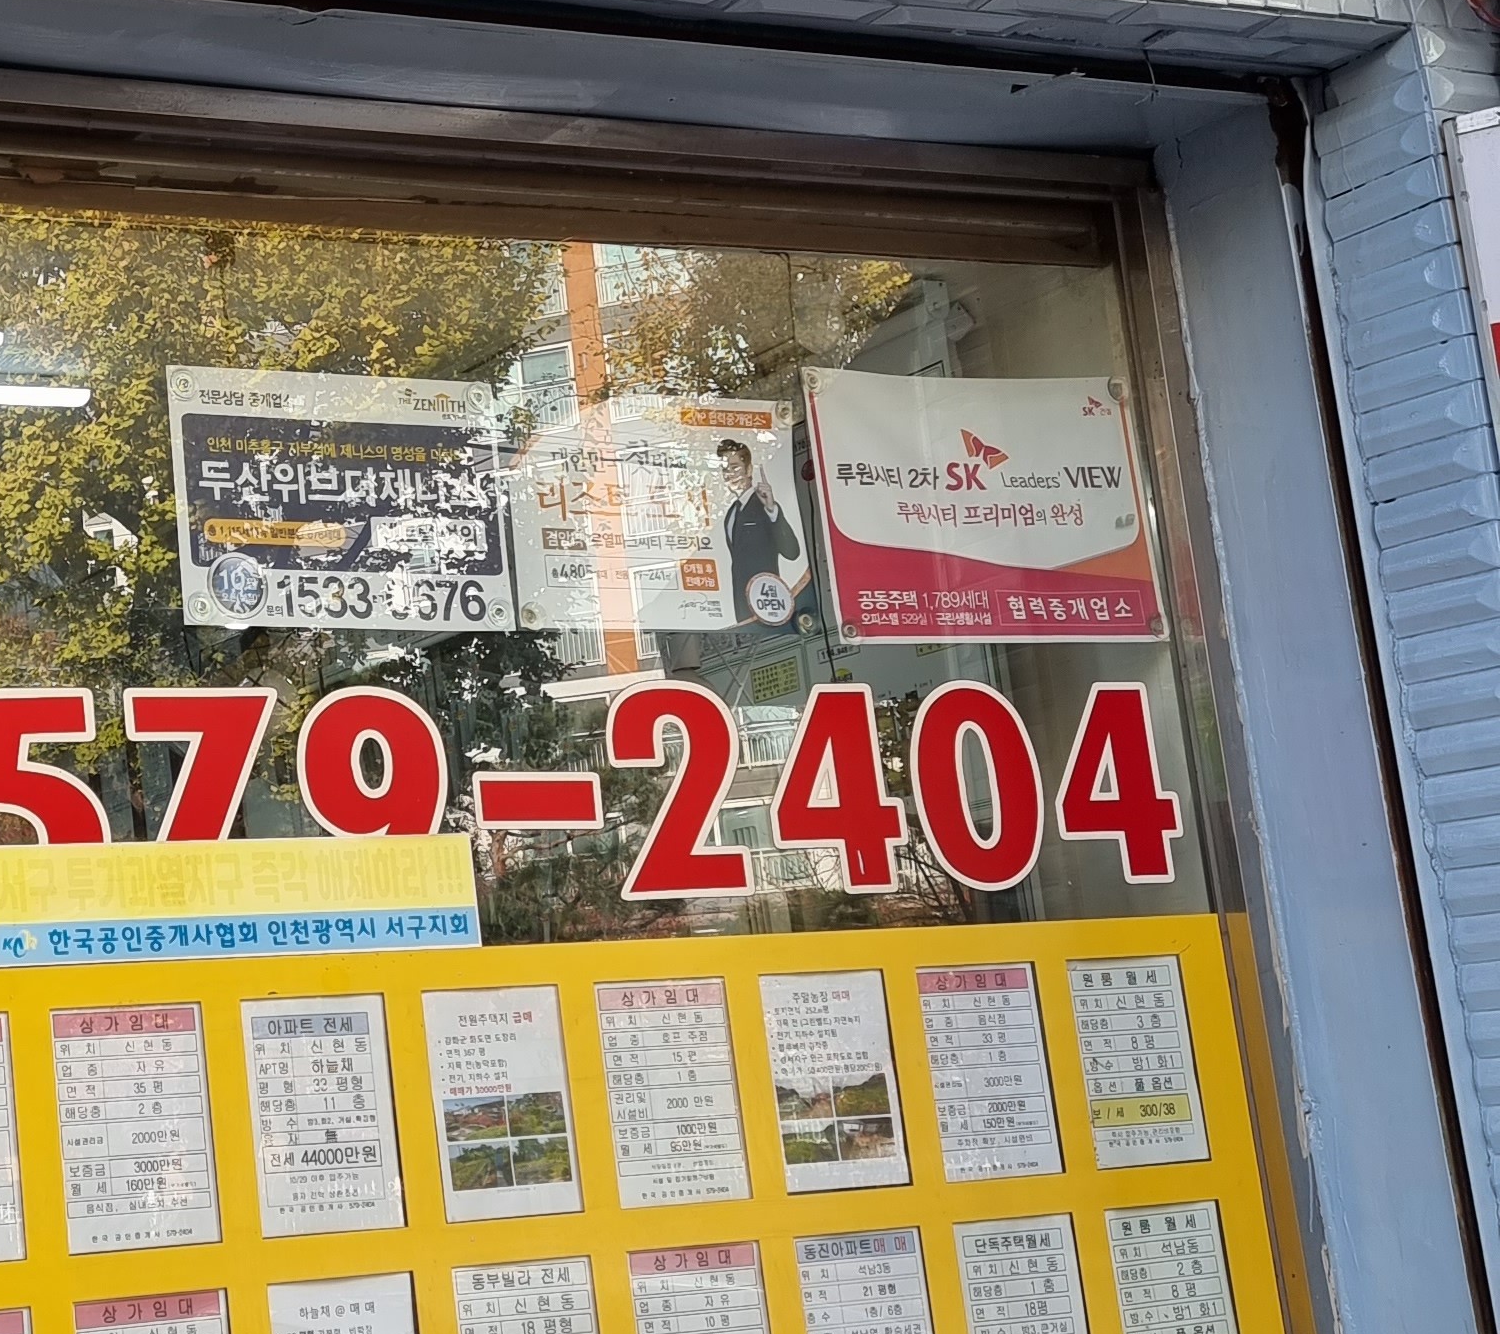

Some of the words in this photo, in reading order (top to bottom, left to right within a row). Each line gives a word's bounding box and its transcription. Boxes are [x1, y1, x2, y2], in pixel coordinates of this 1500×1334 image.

[199, 390, 244, 405] 전문상담
[1082, 407, 1095, 416] SK
[206, 436, 232, 453] 인천
[340, 443, 387, 459] 제니스의
[391, 446, 426, 462] 명성을
[836, 464, 902, 490] 루원시티
[908, 468, 939, 490] 2차
[945, 463, 988, 491] SK
[1062, 467, 1122, 489] VIEW
[897, 502, 958, 527] 루원시티
[964, 504, 1047, 527] 프리미엄의
[1050, 503, 1083, 526] 완성
[665, 536, 713, 550] 푸르지오
[760, 583, 777, 597] 4월
[756, 599, 786, 611] OPEN
[858, 591, 918, 610] 공동주택
[923, 591, 989, 610] 1,789세대
[1007, 595, 1134, 620] 협력중개업소
[861, 613, 899, 626] 오피스텔
[902, 614, 928, 625] 529실
[936, 613, 992, 626] 근린생활시설
[0, 858, 58, 913] 서구
[67, 855, 245, 909] 투기과열지구
[251, 850, 307, 904] 즉각
[48, 926, 258, 957] 한국공인중개사협회
[267, 919, 376, 948] 인천광역시
[385, 911, 469, 941] 서구지회
[268, 1017, 315, 1035] 아파트
[324, 1016, 353, 1034] 전세
[311, 1057, 354, 1074] 하늘채
[1140, 1102, 1175, 1118] 300/38
[131, 1129, 180, 1145] 2000만원
[270, 1151, 295, 1167] 전세
[300, 1144, 377, 1167] 44000만원
[133, 1158, 183, 1174] 3000만원
[974, 1233, 1051, 1253] 단독주택월세
[1160, 1238, 1199, 1256] 석남동
[472, 1271, 532, 1291] 동부빌라
[541, 1266, 571, 1284] 전세
